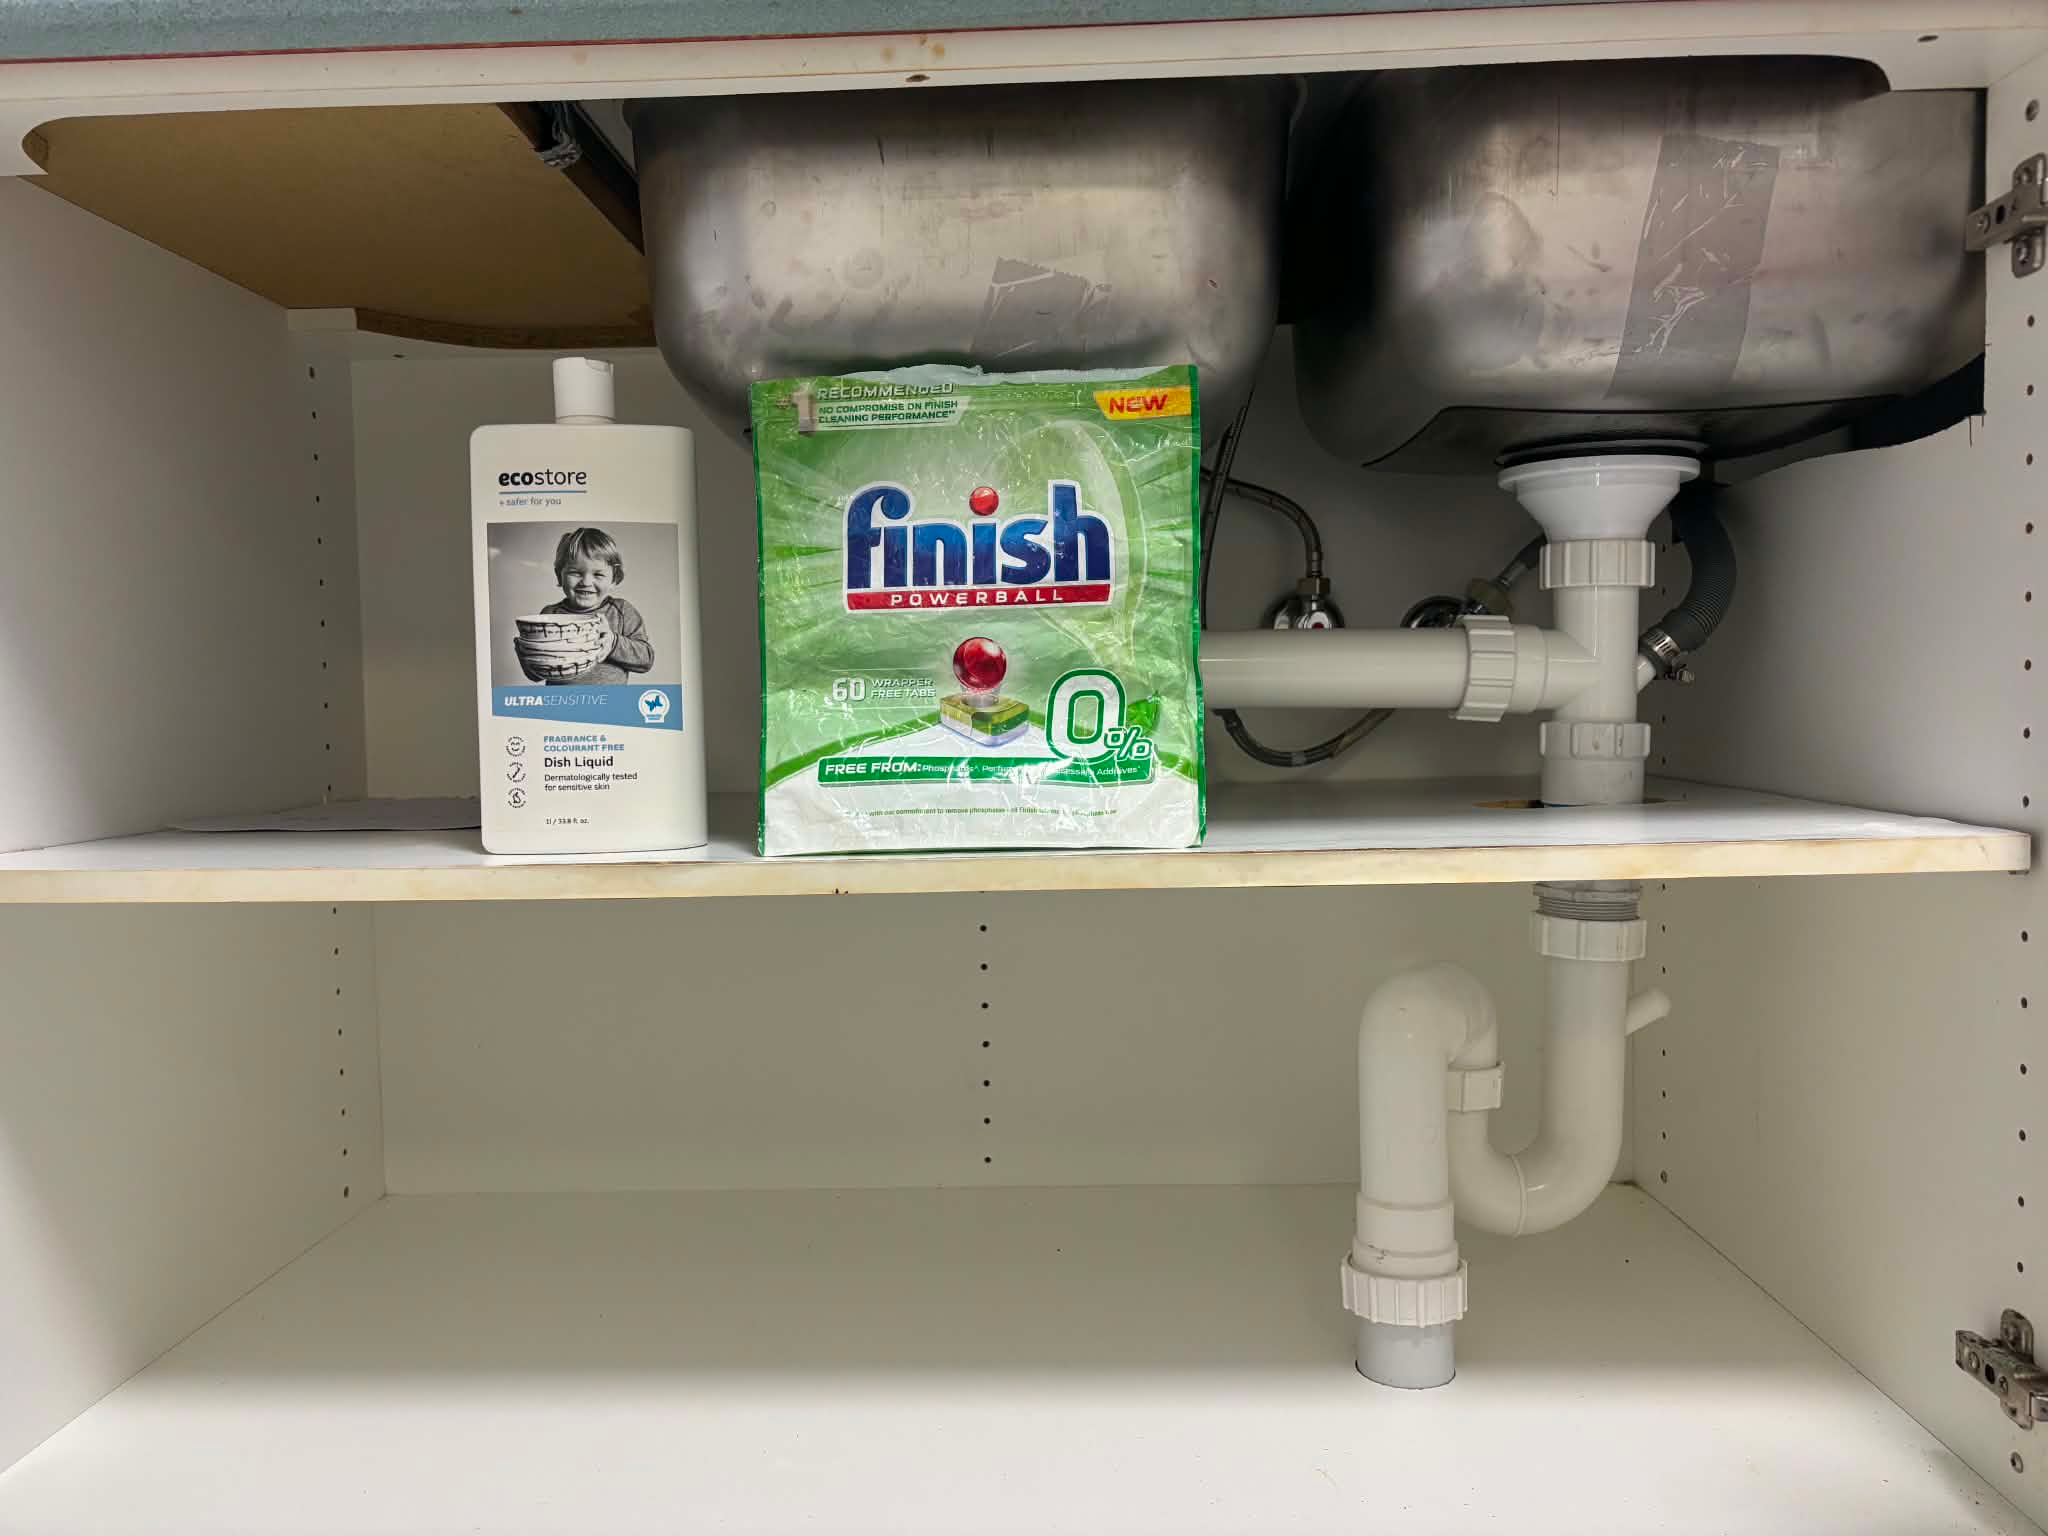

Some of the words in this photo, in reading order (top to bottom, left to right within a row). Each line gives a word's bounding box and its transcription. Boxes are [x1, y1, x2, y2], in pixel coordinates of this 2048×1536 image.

[818, 406, 834, 415] NO
[836, 402, 905, 413] COMPROMISE
[907, 402, 922, 411] ON
[924, 400, 958, 410] FINISH
[1109, 394, 1168, 414] NEW
[818, 413, 872, 424] CLEANING
[498, 468, 587, 486] ecostore
[530, 495, 543, 505] for
[545, 498, 562, 508] you
[845, 481, 1112, 590] finish
[890, 588, 1064, 607] POWERBALL
[832, 677, 866, 701] 60
[871, 678, 936, 688] WRAPPER
[870, 689, 903, 699] FREE
[904, 687, 937, 698] TABS
[543, 735, 598, 743] FRAGRANCE
[599, 734, 608, 742] &
[543, 744, 599, 752] COLOURANT
[601, 743, 625, 752] FREE
[544, 756, 571, 768] Dish
[574, 755, 614, 769] Liquid
[825, 762, 868, 776] FREE
[870, 760, 922, 774] FROM:
[544, 773, 611, 783] Dermatologically
[612, 772, 639, 781] tested
[544, 783, 557, 792] for
[557, 783, 593, 792] sensitive
[593, 782, 611, 791] skin
[895, 806, 936, 816] commitment
